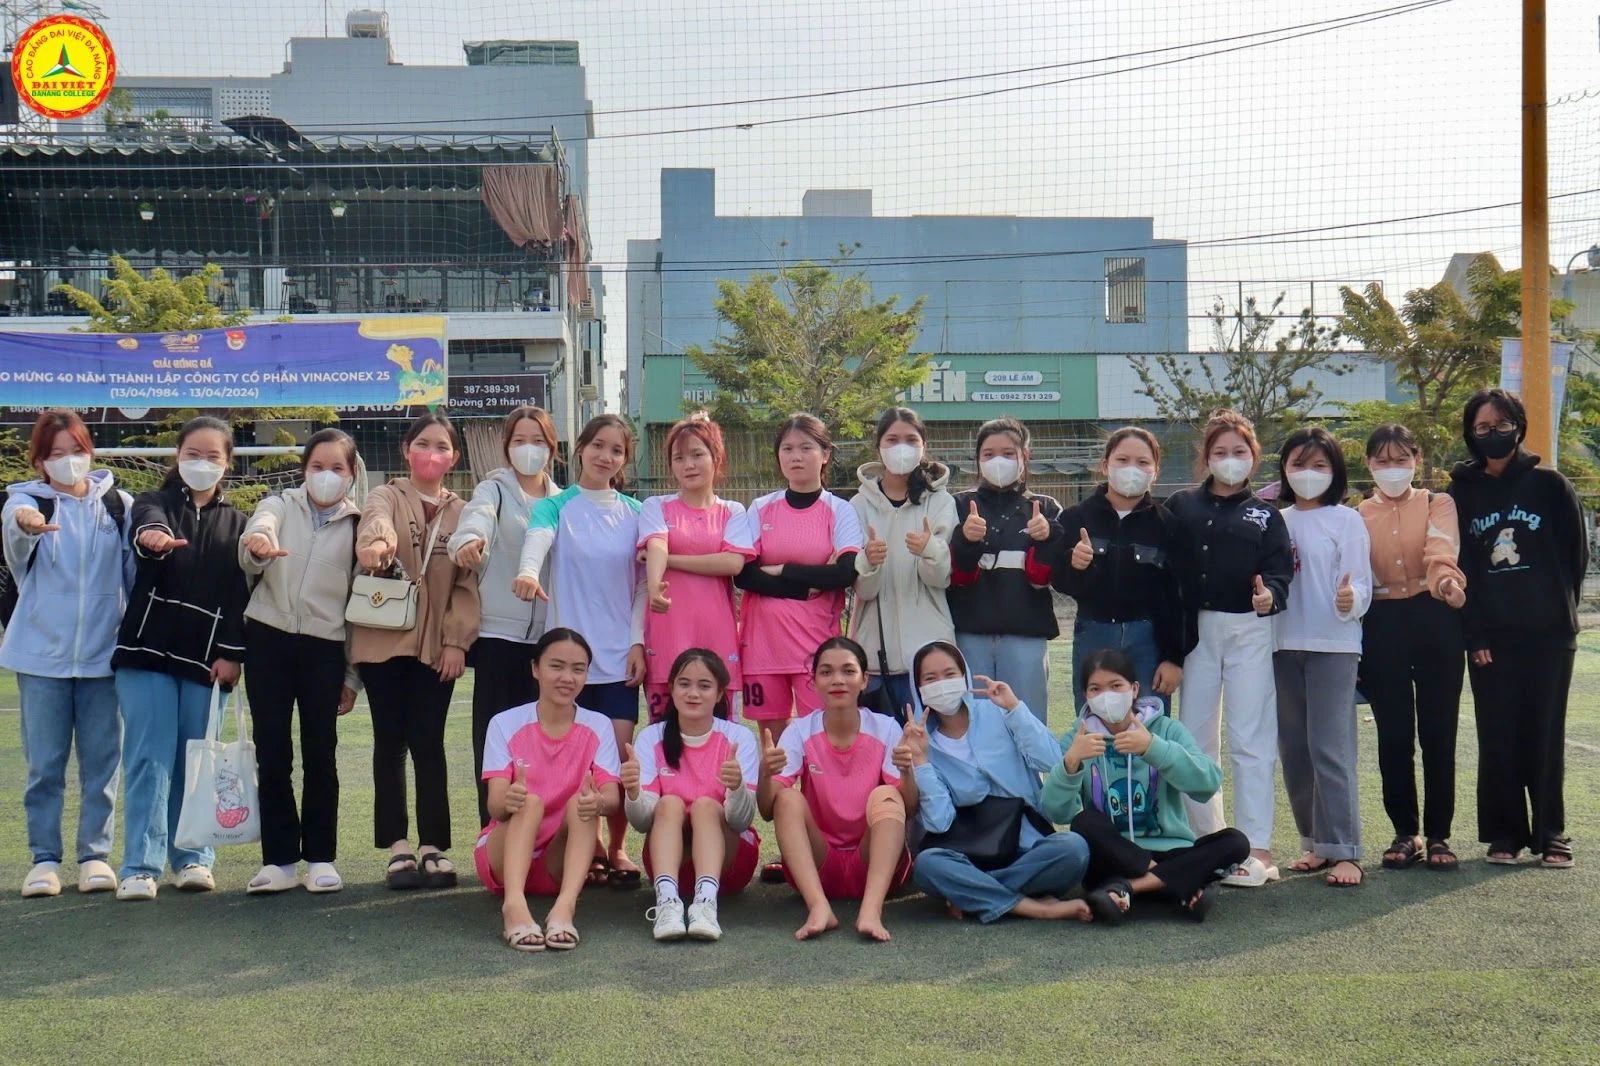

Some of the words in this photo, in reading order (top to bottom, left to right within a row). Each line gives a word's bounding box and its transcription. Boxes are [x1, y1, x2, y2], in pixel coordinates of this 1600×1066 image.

[13, 369, 54, 382] MỪNG
[57, 373, 74, 383] 40
[76, 371, 106, 383] NĂM
[109, 371, 154, 384] THÀNH
[157, 371, 181, 386] LẬP
[184, 371, 221, 384] CÔNG
[223, 373, 239, 383] TY
[301, 371, 374, 383] VINACONEX
[376, 371, 391, 381] 25
[992, 374, 1007, 382] 208
[110, 387, 179, 399] (13/04/1984
[189, 387, 260, 399] 13/04/2024)
[463, 384, 521, 395] 387-389-391
[449, 398, 484, 408] Đường
[485, 398, 498, 406] 29
[499, 397, 528, 407] tháng
[529, 397, 536, 405] 3
[1469, 503, 1542, 538] Runing
[742, 682, 764, 707] 09
